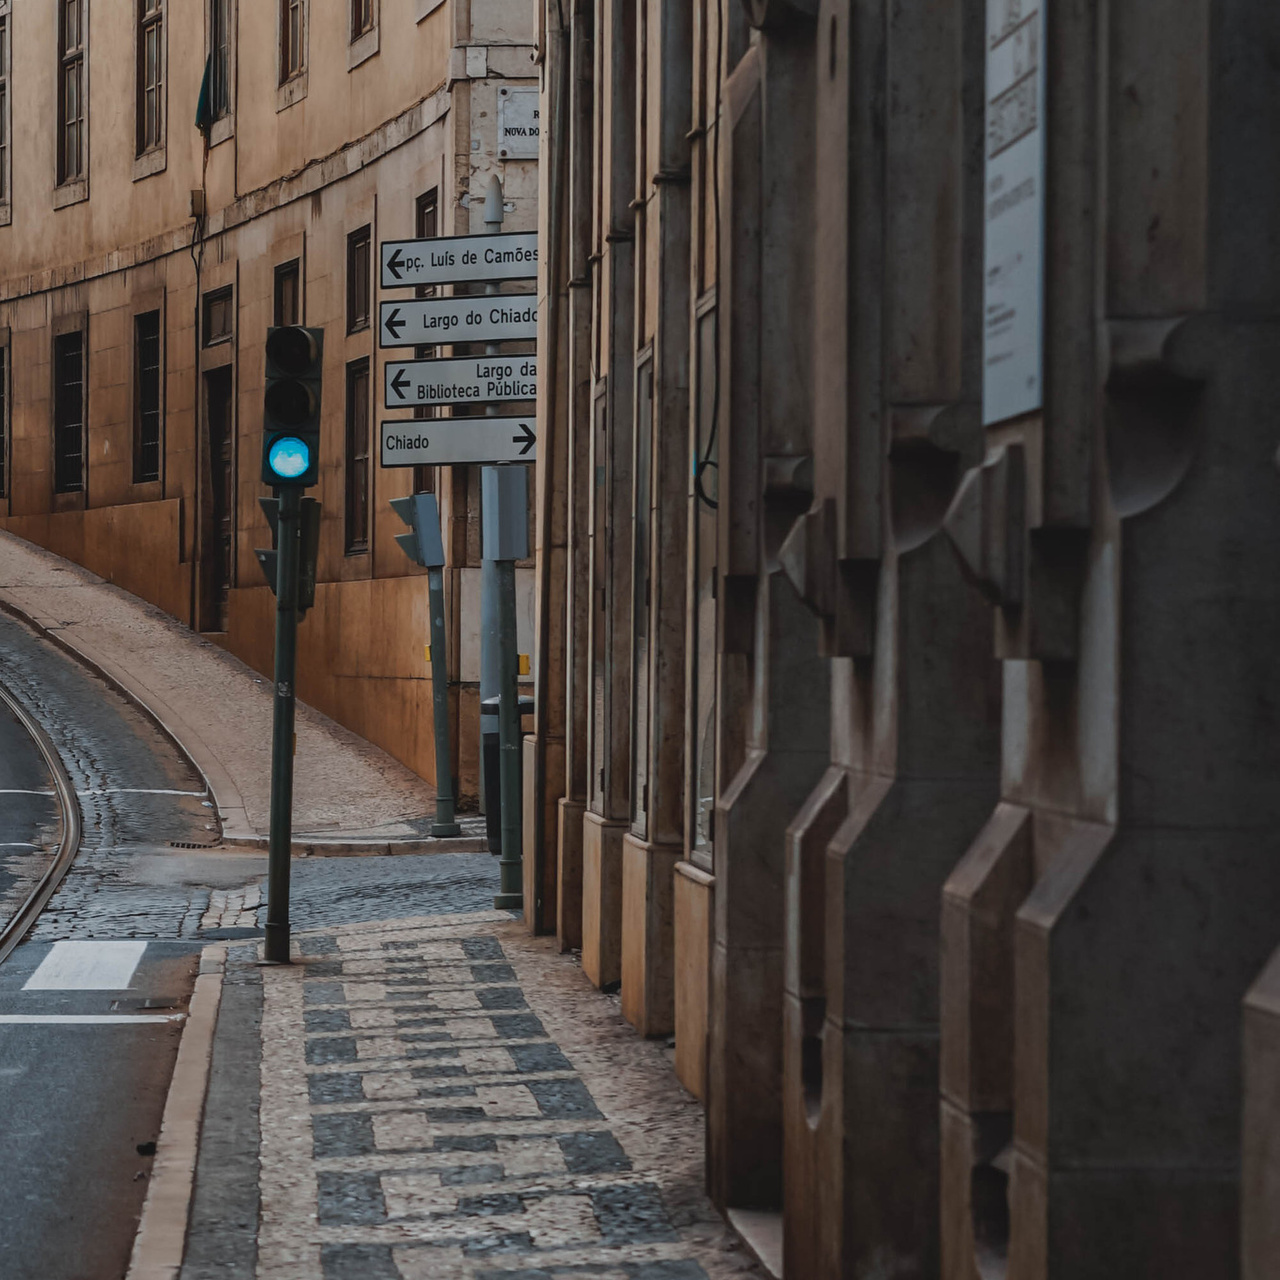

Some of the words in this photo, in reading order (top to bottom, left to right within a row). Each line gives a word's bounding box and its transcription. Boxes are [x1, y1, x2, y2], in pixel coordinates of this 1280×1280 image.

[504, 127, 527, 137] NOVA
[431, 251, 455, 267] Luís
[462, 250, 478, 265] de
[484, 247, 538, 264] Camões
[423, 314, 459, 330] Largo
[466, 310, 482, 325] do
[476, 363, 513, 380] Largo
[520, 362, 537, 376] da
[417, 383, 480, 400] Biblioteca
[487, 380, 537, 396] Pública
[386, 434, 429, 450] Chiado
